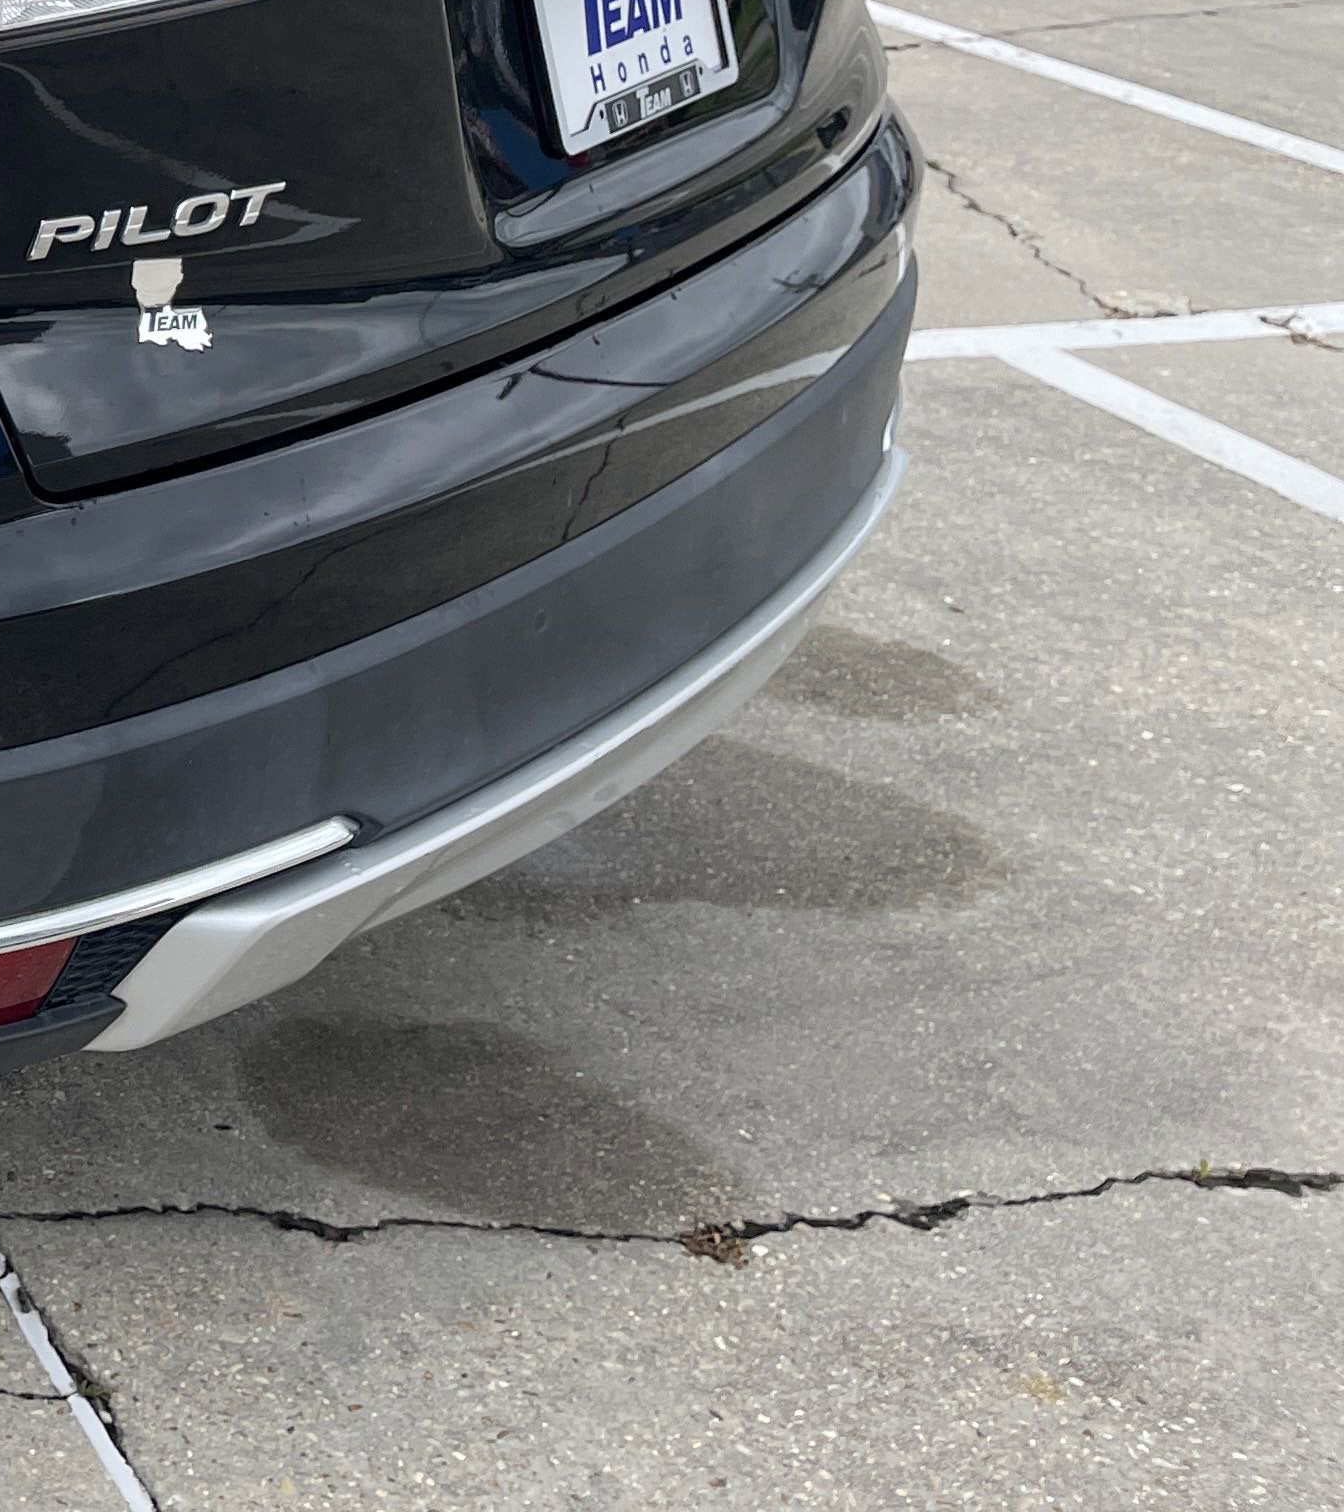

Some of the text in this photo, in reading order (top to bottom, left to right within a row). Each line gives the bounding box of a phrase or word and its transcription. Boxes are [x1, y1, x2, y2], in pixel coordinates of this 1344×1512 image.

[636, 85, 672, 119] TEAM
[26, 181, 287, 261] PILOT
[143, 307, 198, 333] TEAM
